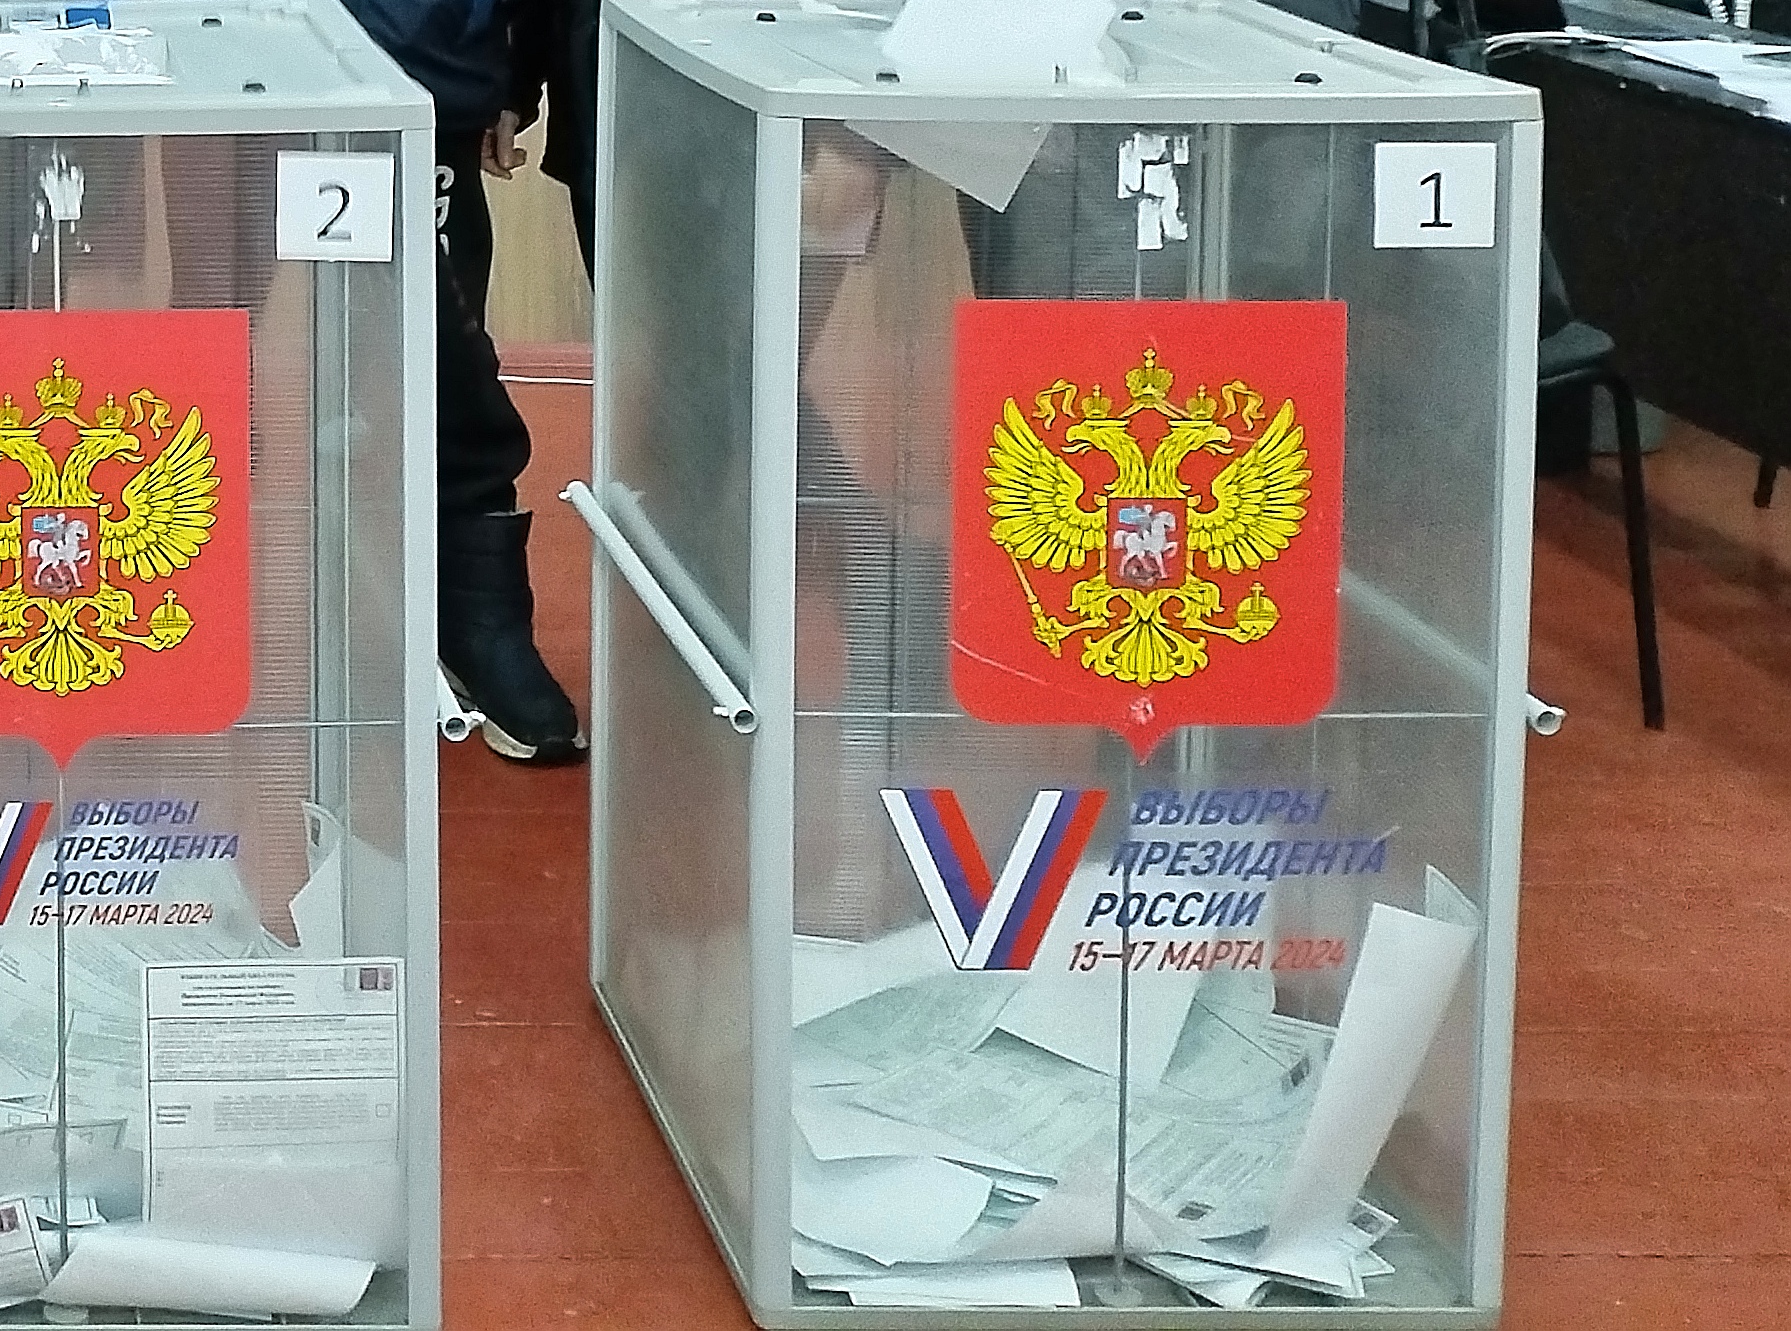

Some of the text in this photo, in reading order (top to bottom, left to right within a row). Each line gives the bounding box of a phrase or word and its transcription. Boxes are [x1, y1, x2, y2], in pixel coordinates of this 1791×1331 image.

[316, 182, 352, 242] 2
[1420, 172, 1453, 228] 1
[69, 801, 201, 826] ВЫБОРЫ
[1130, 789, 1329, 826] ВЫБОРЫ
[54, 834, 240, 864] ПРЕЗИДЕНТА
[1107, 839, 1388, 881] ПРЕЗИДЕНТА
[38, 871, 160, 896] РОССИИ
[90, 904, 159, 925] МАРТА
[163, 903, 215, 925] 2024
[1084, 891, 1267, 928] РОССИИ
[1157, 940, 1265, 971] МАРТА
[1272, 938, 1346, 971] 2024
